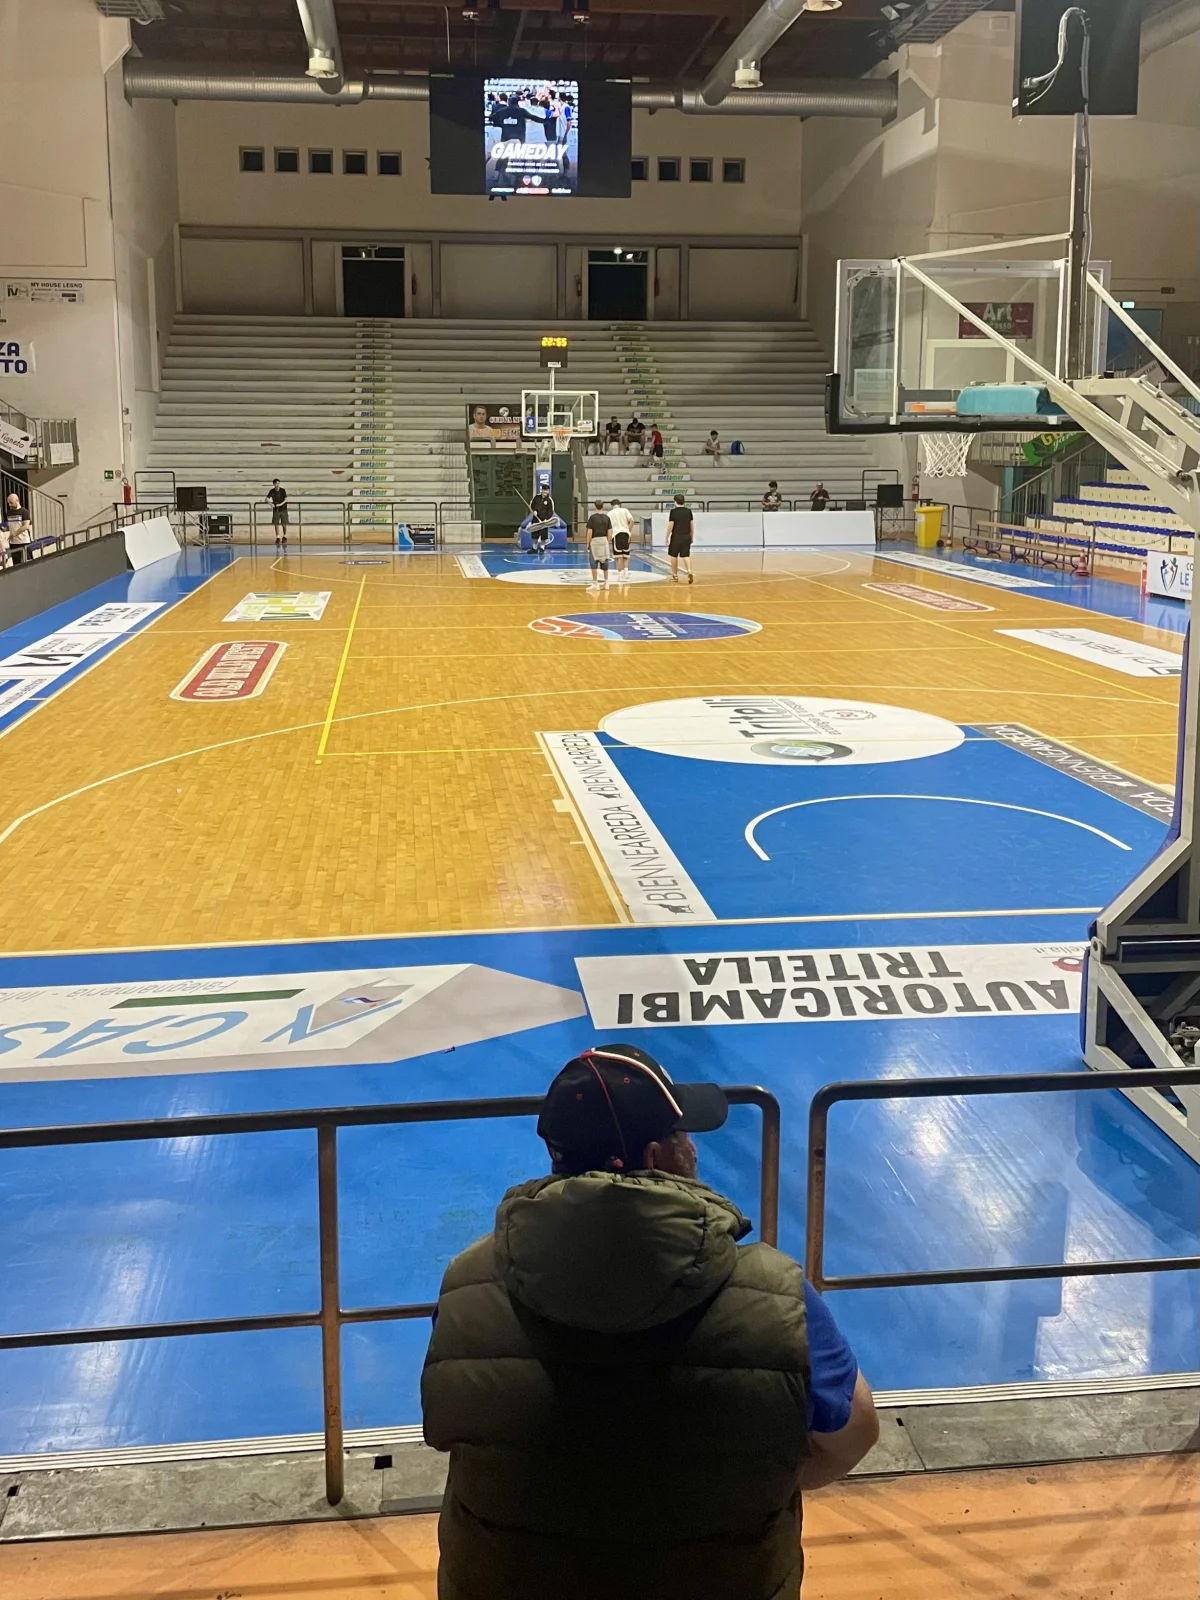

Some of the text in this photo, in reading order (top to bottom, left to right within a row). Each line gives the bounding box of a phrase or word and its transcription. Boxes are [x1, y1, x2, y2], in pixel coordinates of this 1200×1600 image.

[490, 142, 569, 160] GAMEDAY
[983, 303, 1012, 321] Art
[1, 432, 25, 449] Vigneto
[1186, 562, 1194, 571] CO
[193, 643, 268, 697] OLD WILD WEST
[702, 698, 819, 738] Tritelli
[560, 732, 619, 797] BIENNEARREDA
[986, 725, 1120, 783] BIENNEARREDA
[600, 805, 689, 902] BIENNEARREDA
[683, 952, 962, 986] TRITELLA
[67, 979, 238, 1001] Falegnameria
[616, 979, 1070, 1024] AUTORICAMBI
